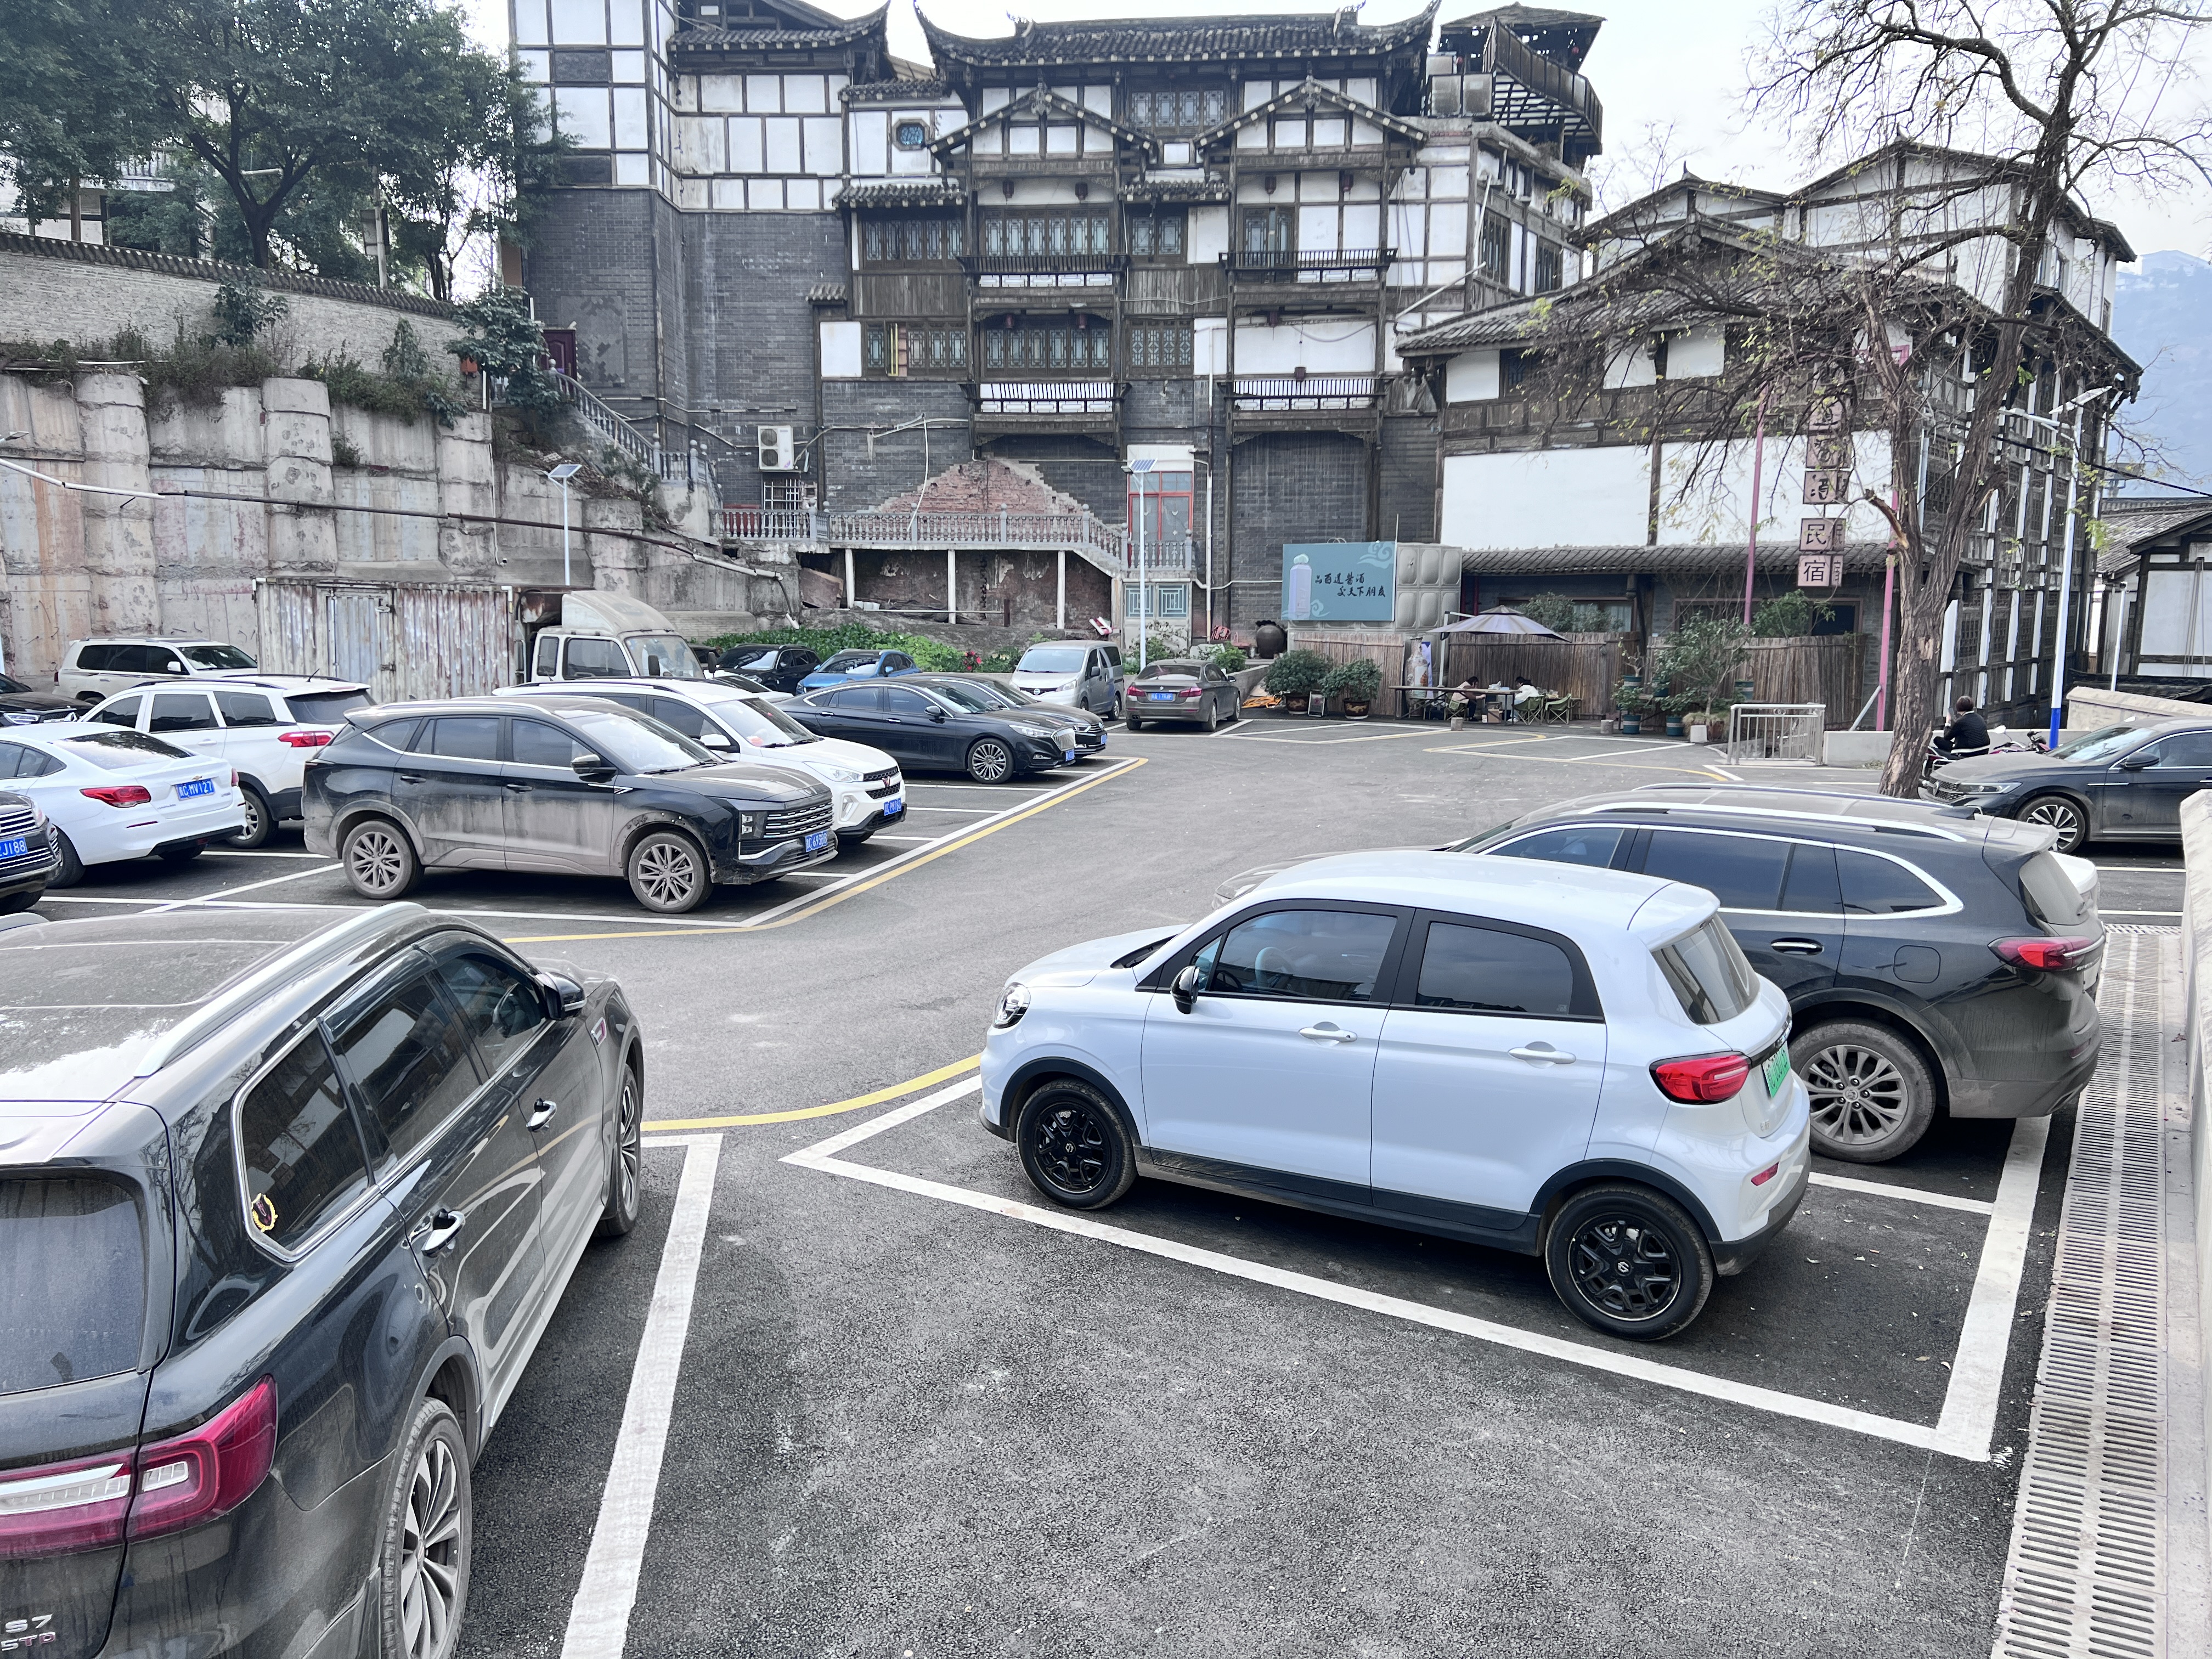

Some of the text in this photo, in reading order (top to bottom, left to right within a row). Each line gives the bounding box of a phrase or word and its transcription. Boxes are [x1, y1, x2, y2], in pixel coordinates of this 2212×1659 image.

[1337, 585, 1386, 597] 交天下朋友
